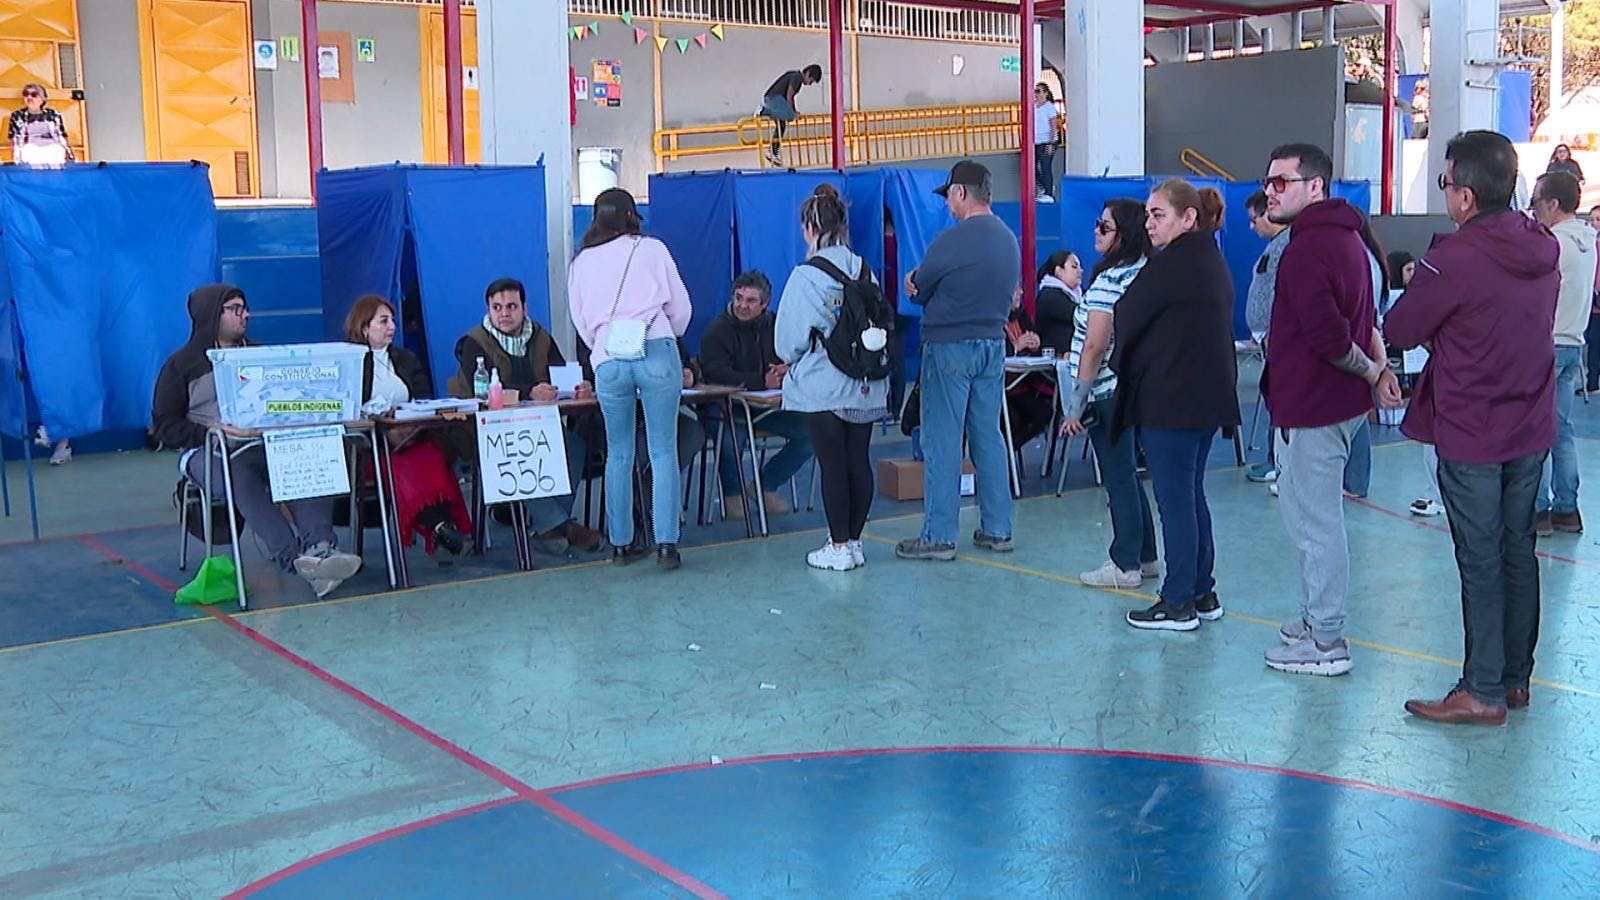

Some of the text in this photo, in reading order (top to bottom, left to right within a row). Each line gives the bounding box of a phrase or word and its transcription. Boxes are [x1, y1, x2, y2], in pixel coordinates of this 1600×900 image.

[268, 402, 302, 412] PUEBLOS
[486, 429, 551, 459] MESA
[497, 458, 556, 497] 556
